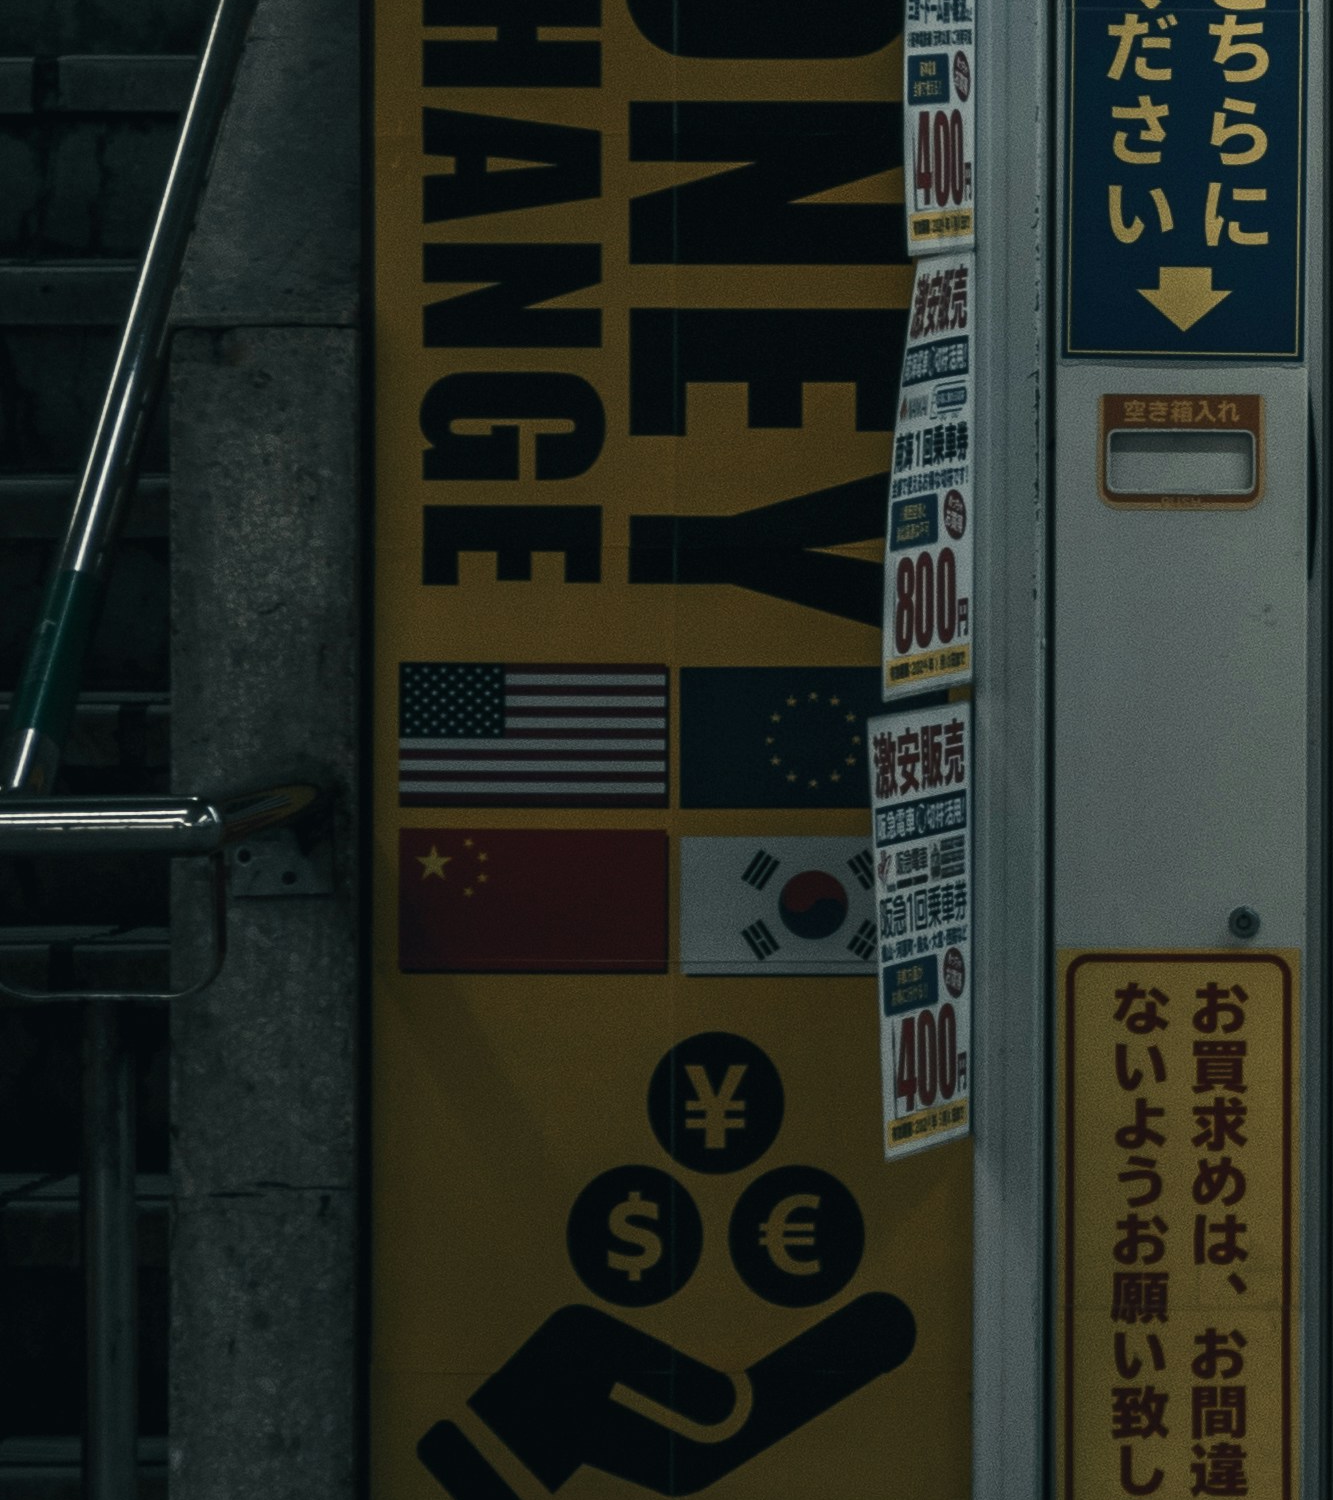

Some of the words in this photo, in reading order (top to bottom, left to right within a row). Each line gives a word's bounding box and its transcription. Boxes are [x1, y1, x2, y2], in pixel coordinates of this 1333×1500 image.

[1123, 399, 1240, 423] 空き箱入れ
[895, 547, 968, 655] 800円
[872, 718, 965, 798] 激安販売
[896, 1003, 967, 1112] 400円
